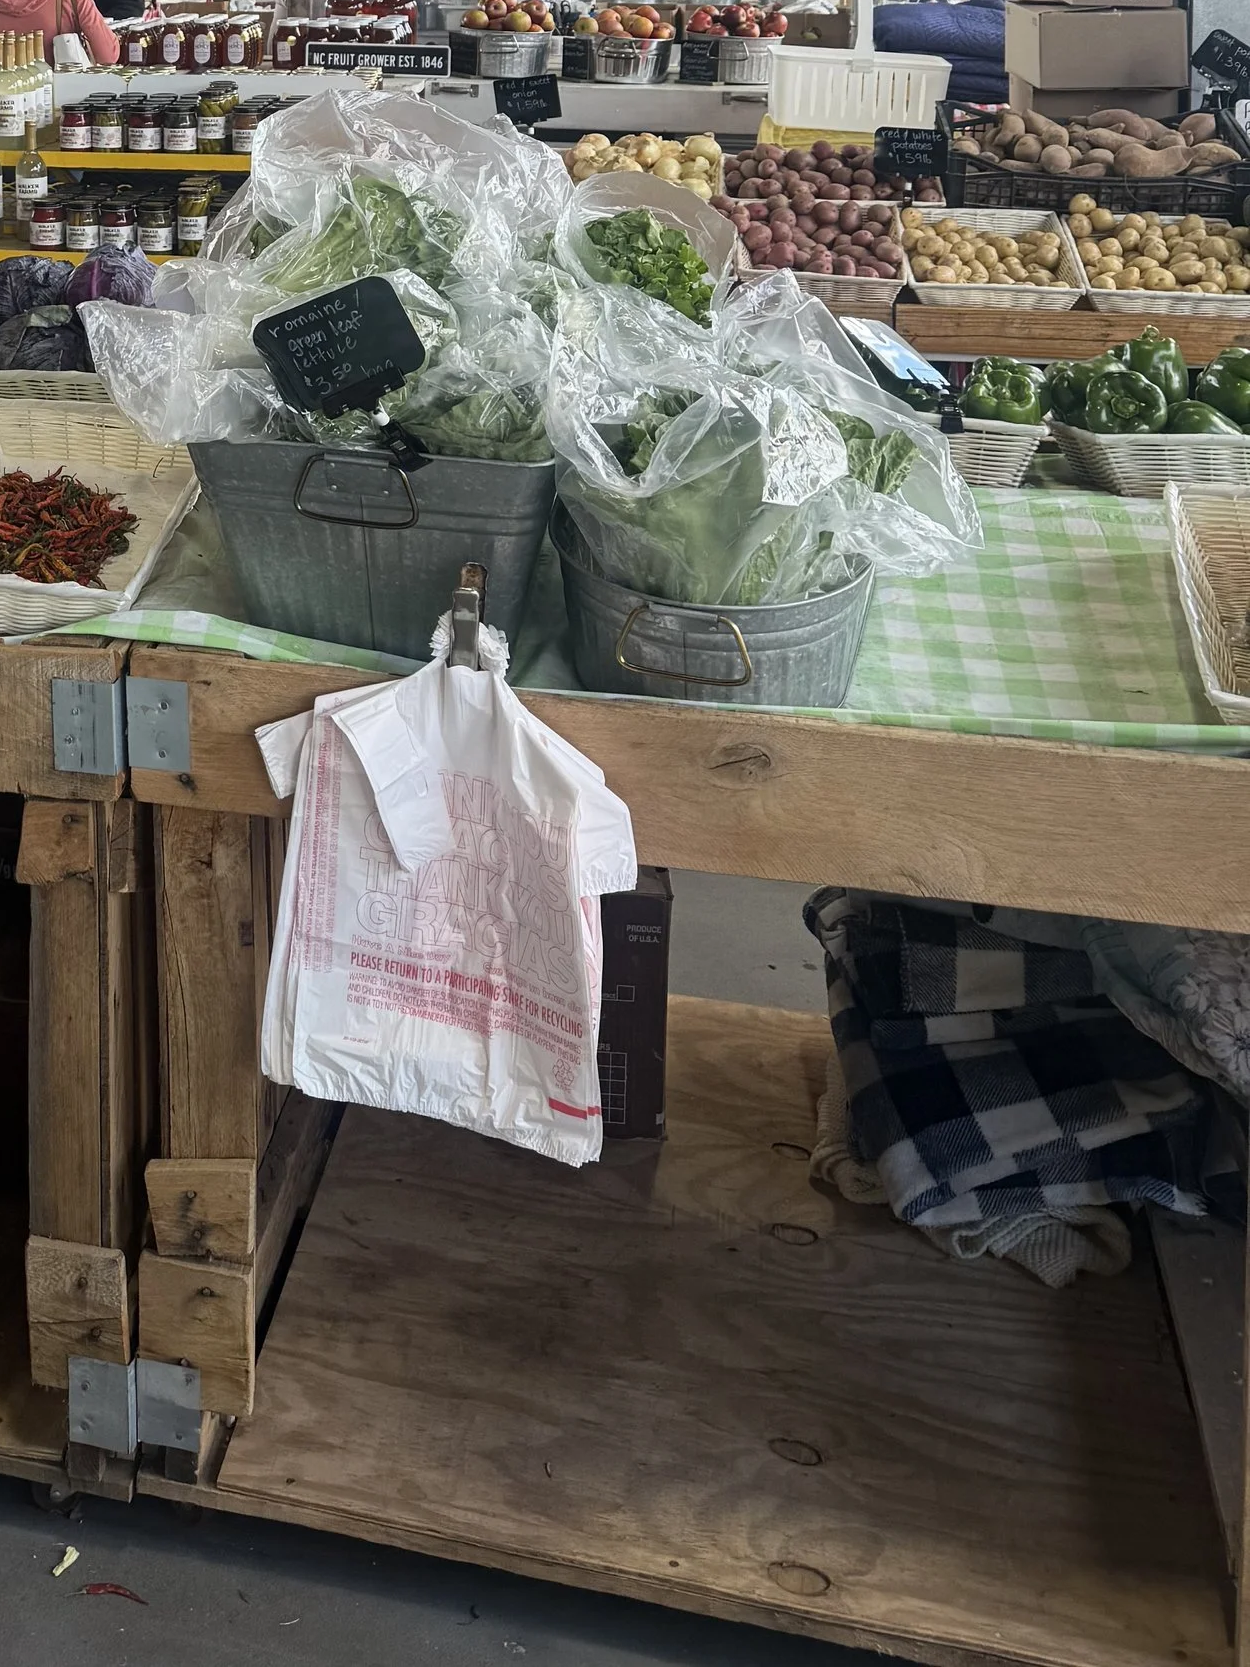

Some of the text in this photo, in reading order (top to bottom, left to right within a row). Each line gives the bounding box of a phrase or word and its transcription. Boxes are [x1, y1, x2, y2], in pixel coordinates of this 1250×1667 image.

[312, 52, 444, 69] NC FRUIT GROWER EST. 1846
[512, 89, 537, 99] onion
[881, 128, 943, 142] red white
[891, 140, 933, 153] potatoes
[268, 298, 347, 338] romaine
[287, 309, 363, 357] green leaf
[292, 335, 358, 372] lettuce
[359, 845, 503, 915] THANK
[626, 924, 662, 934] PRODUCE
[628, 934, 660, 943] OF U.S.A.
[351, 934, 452, 965] Have A Nice Day
[356, 890, 579, 994] GRACIAS
[347, 982, 361, 993] AND
[350, 951, 383, 972] PLEASE
[384, 958, 419, 982] RETURN
[421, 967, 433, 984] TO
[434, 969, 442, 985] A
[525, 998, 540, 1018] FOR
[541, 1005, 583, 1039] RECYCLING
